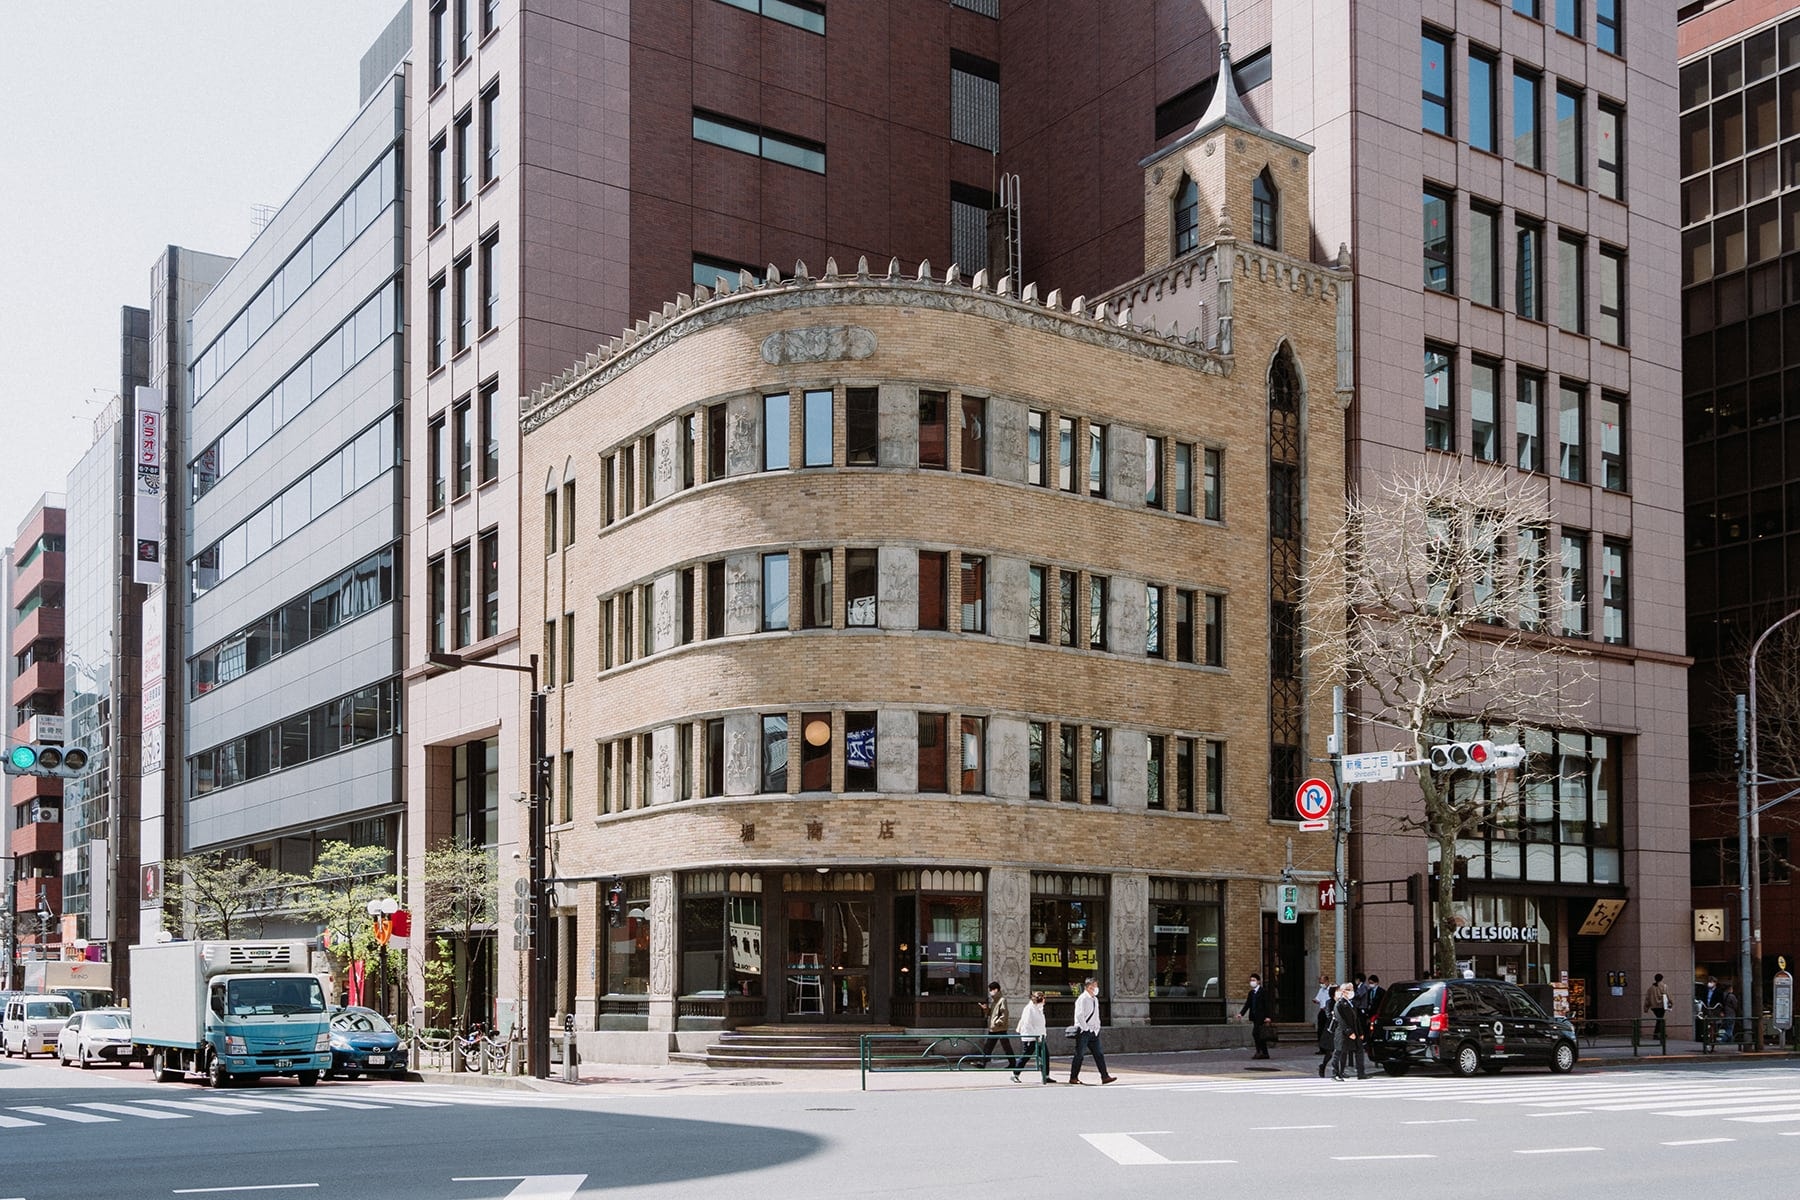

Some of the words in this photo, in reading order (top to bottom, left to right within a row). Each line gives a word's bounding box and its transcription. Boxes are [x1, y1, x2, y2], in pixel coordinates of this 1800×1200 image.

[143, 414, 155, 463] カラオケ
[1346, 755, 1388, 769] 新橋二丁目
[740, 819, 896, 843] 堀商店
[1437, 926, 1519, 940] XCELSIOR
